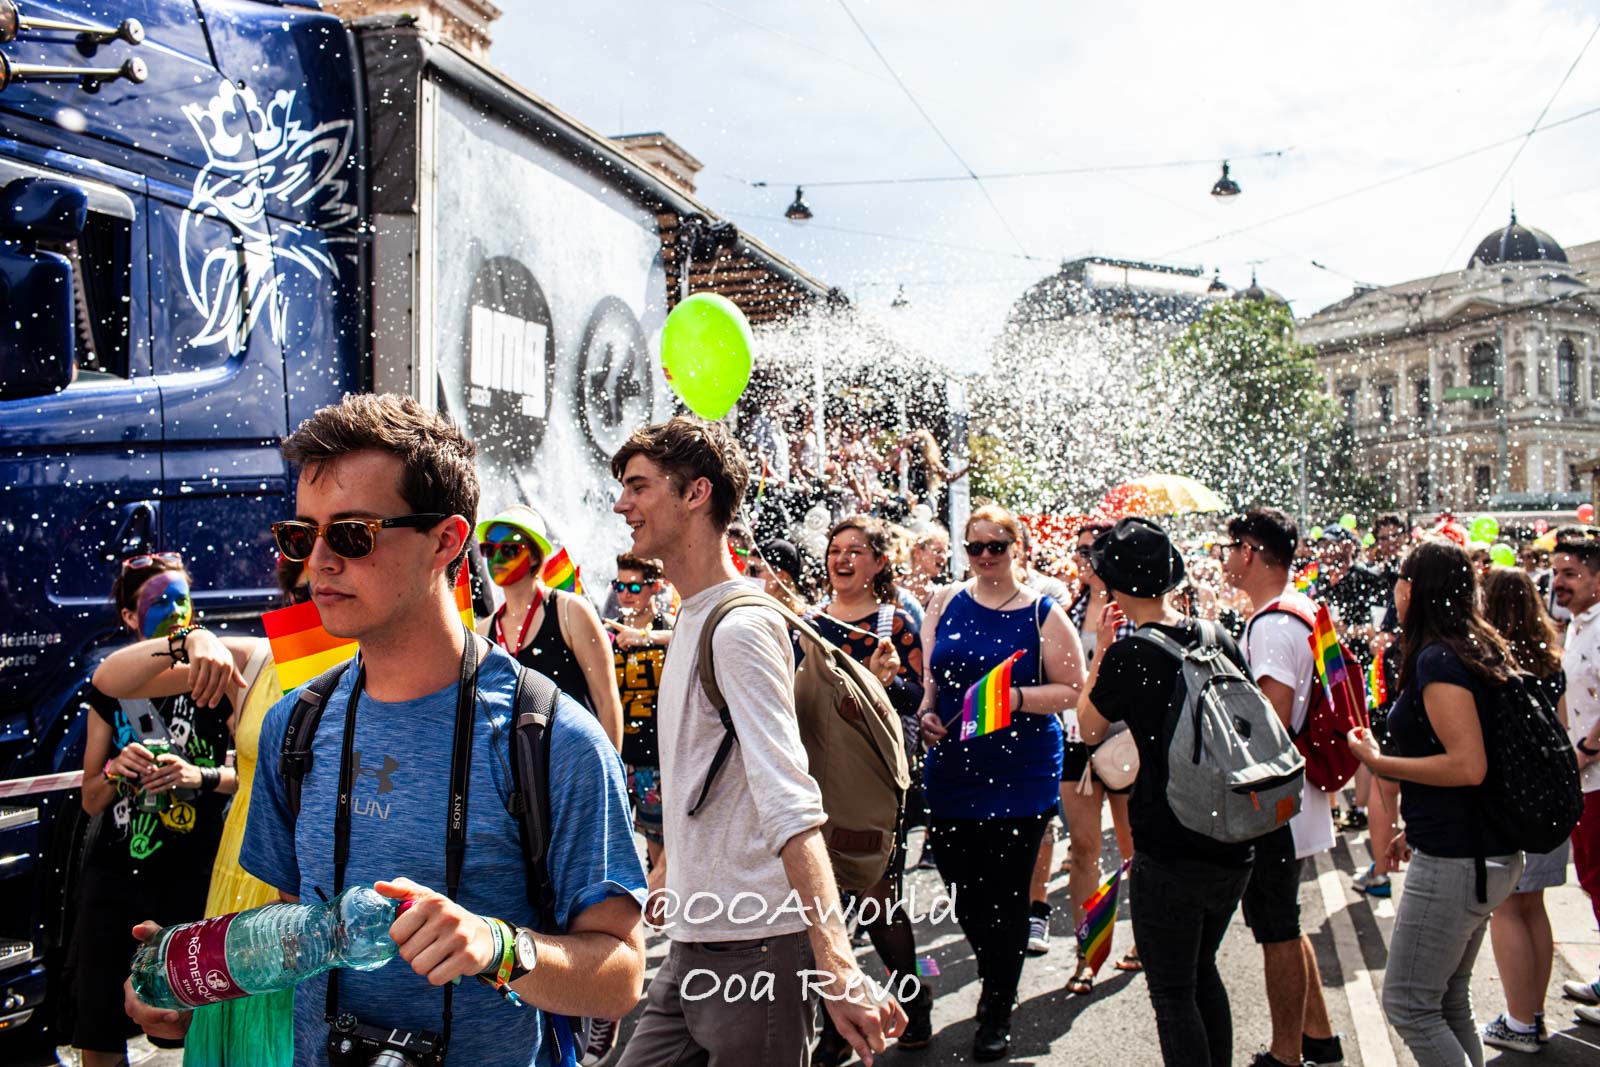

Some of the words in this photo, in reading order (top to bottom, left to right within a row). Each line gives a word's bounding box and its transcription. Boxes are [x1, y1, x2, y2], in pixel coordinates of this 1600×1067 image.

[350, 797, 391, 820] UN
[452, 793, 462, 830] SONY
[182, 979, 195, 995] STILL
